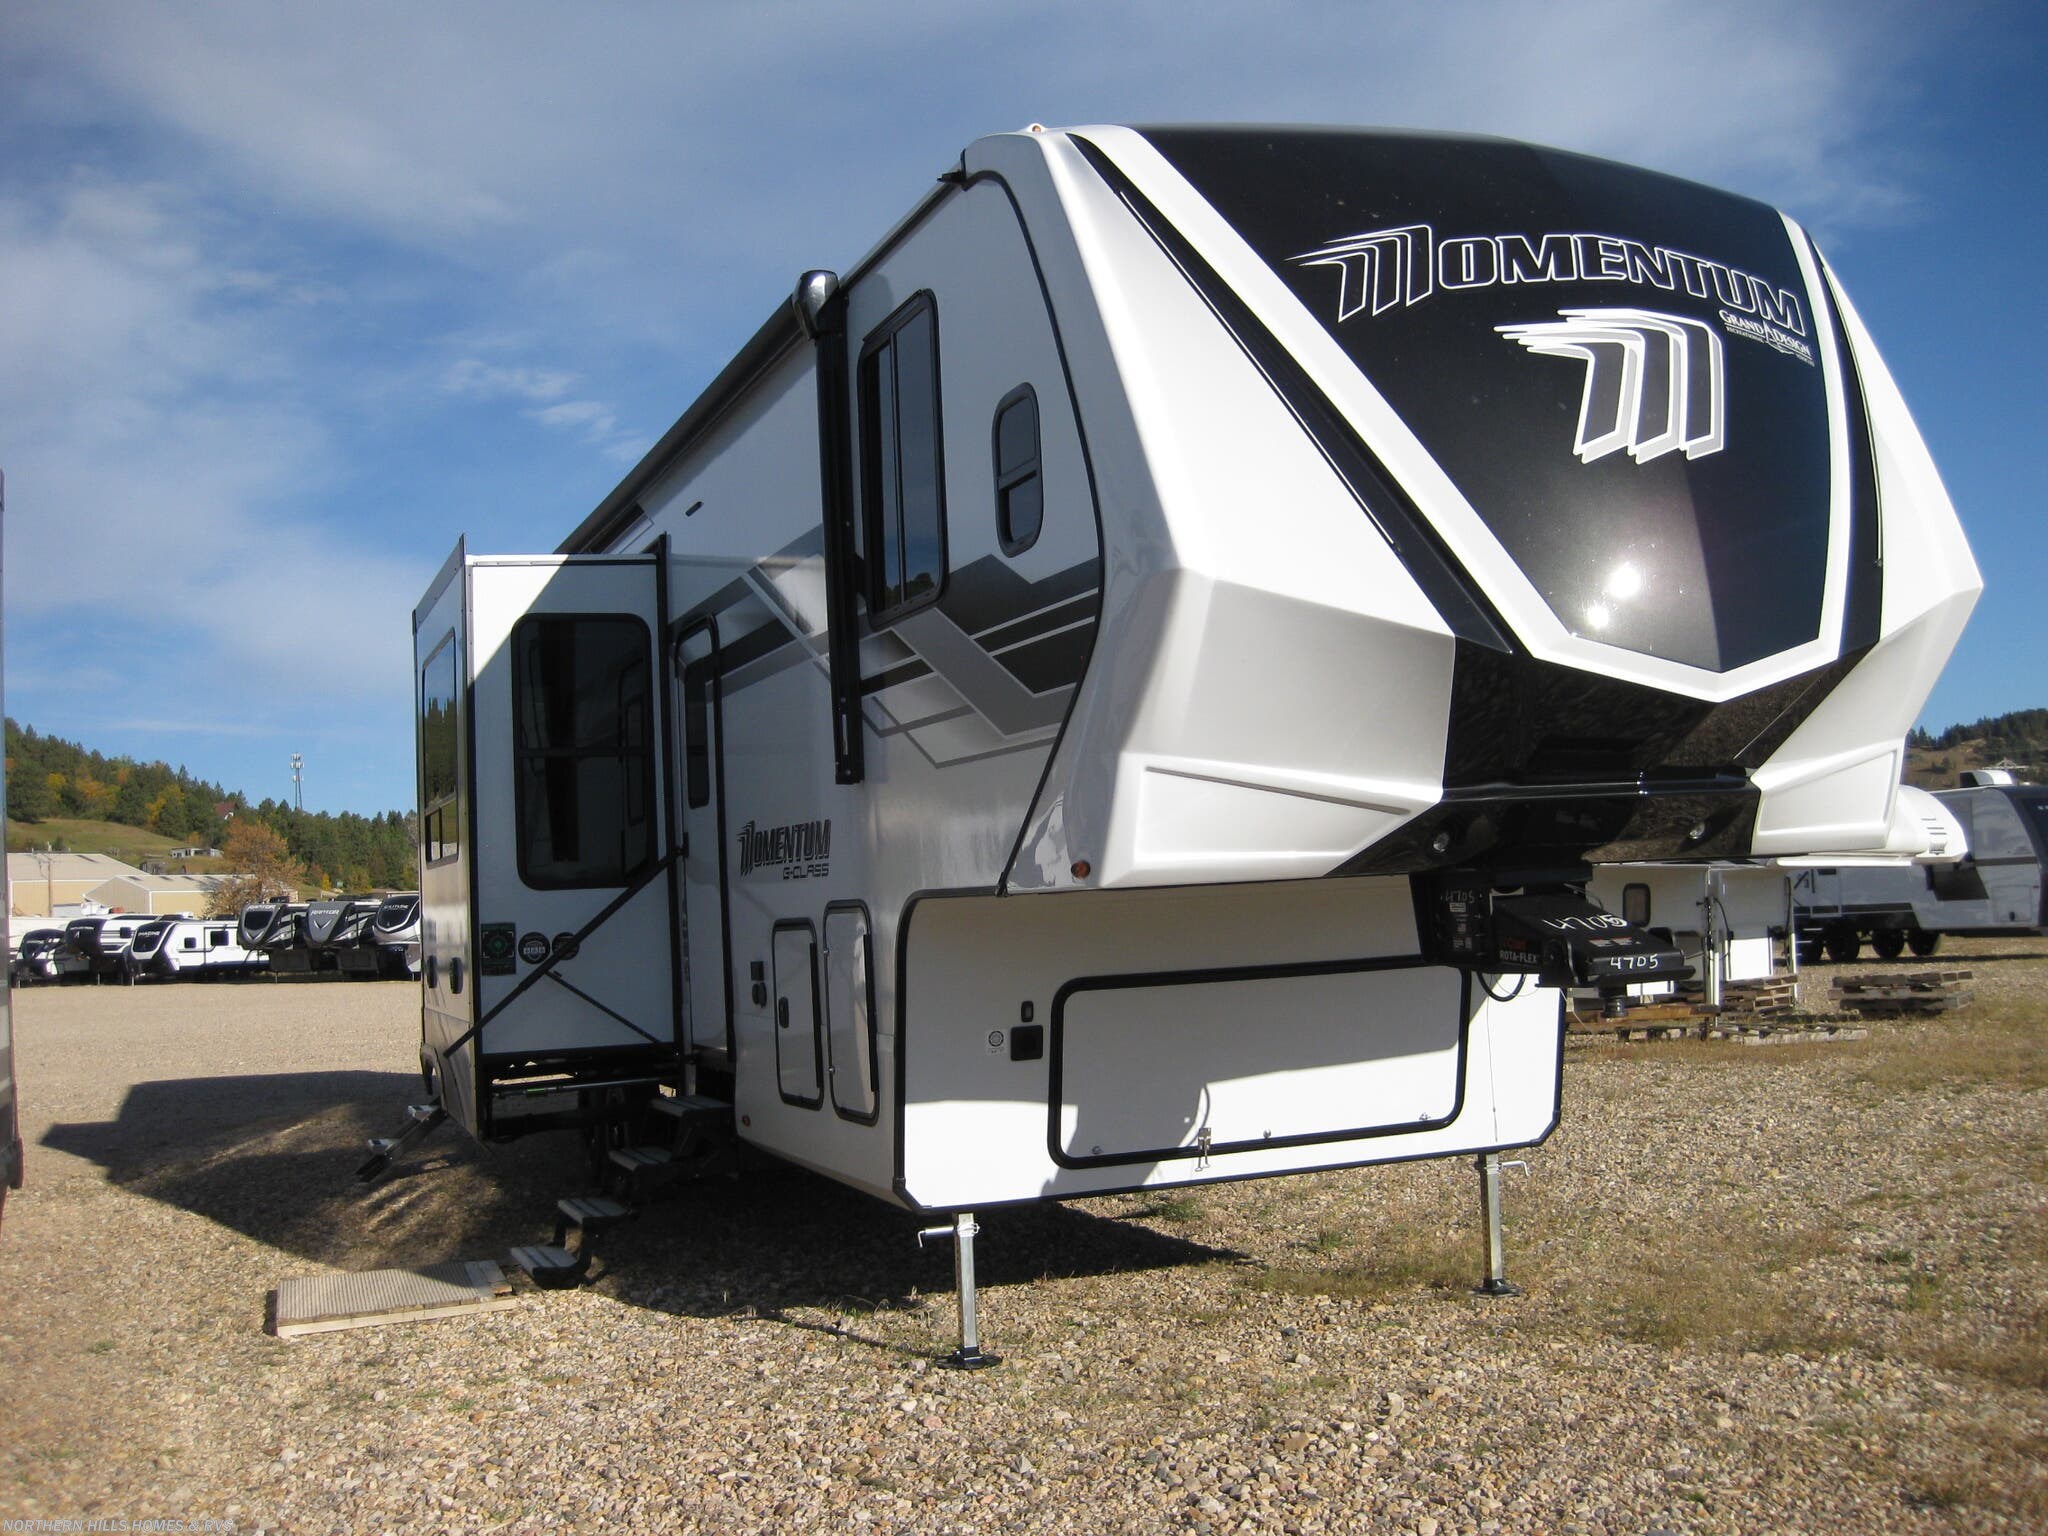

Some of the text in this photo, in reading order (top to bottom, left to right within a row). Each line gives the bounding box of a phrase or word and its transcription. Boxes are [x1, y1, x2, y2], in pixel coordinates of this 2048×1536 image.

[1284, 225, 1806, 337] MOMENTUM
[1718, 309, 1765, 335] GRAND
[737, 819, 831, 877] MOMENTUM
[1610, 953, 1659, 970] 4705
